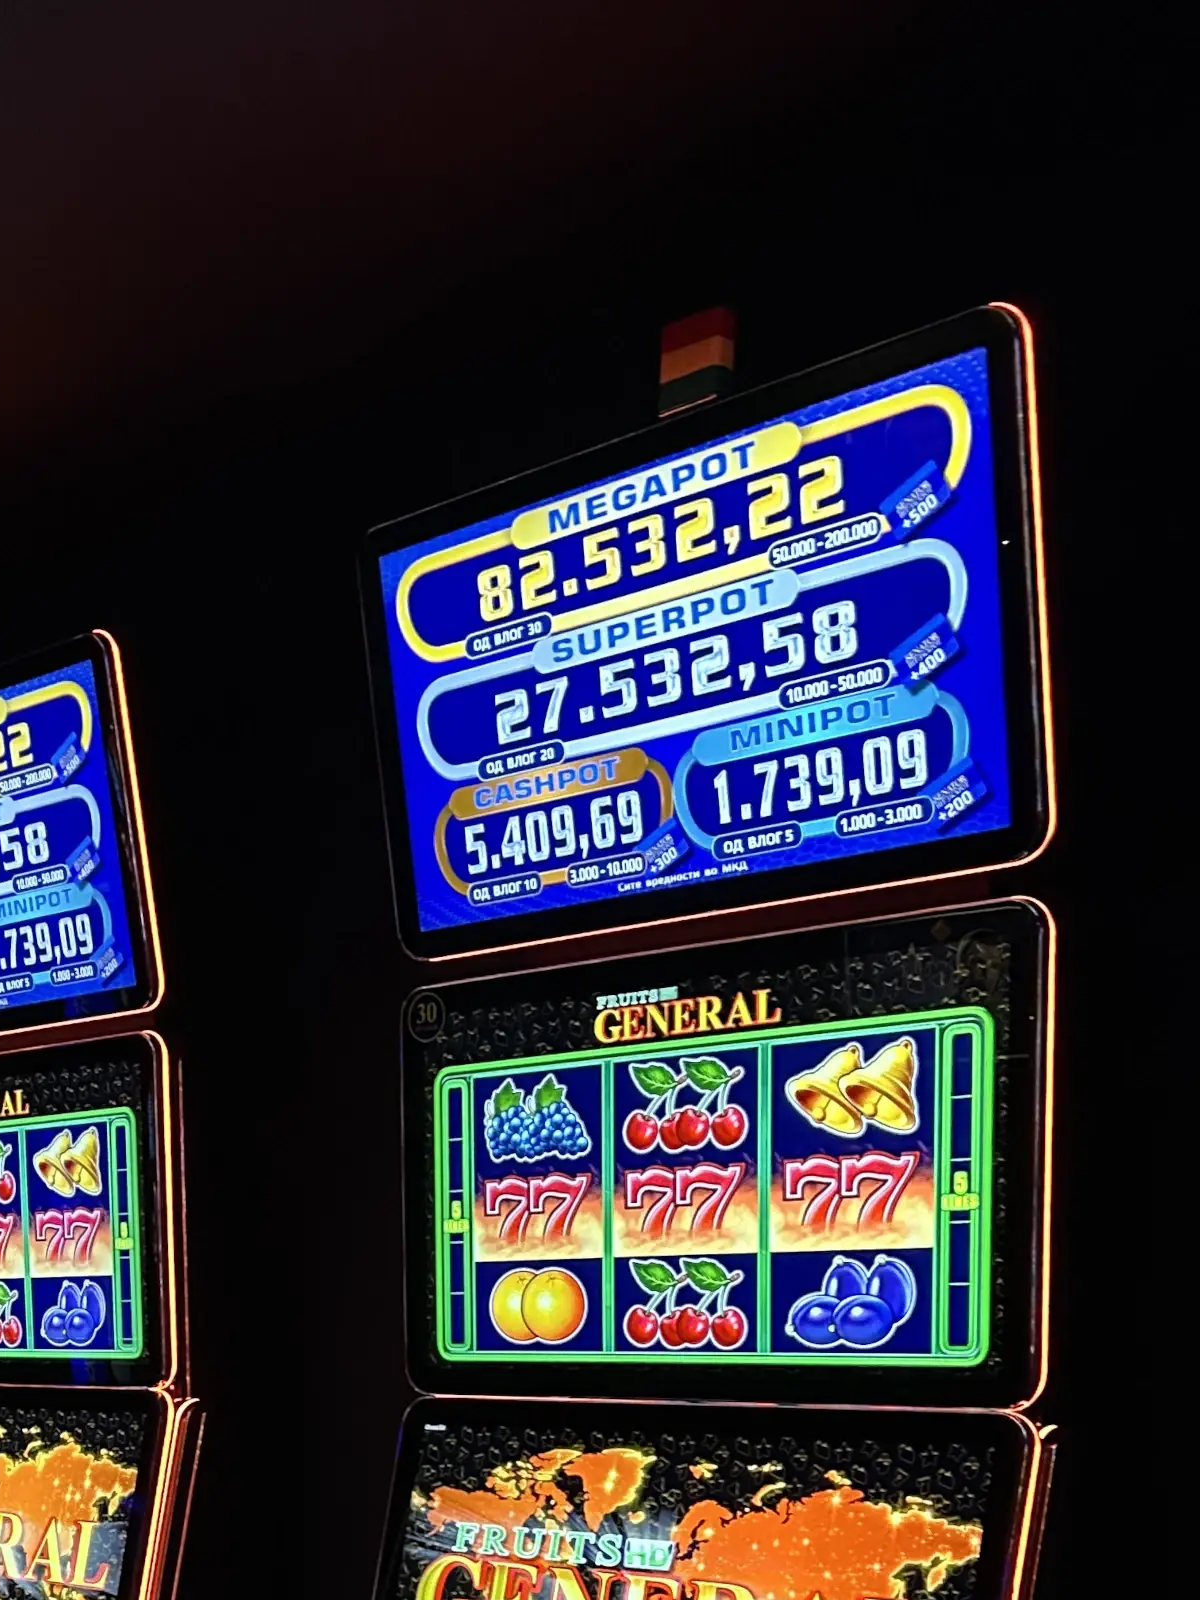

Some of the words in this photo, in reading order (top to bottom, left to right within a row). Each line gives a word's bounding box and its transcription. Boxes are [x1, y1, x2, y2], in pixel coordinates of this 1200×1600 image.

[548, 441, 755, 533] MEGAPOT
[902, 494, 938, 528] +500
[477, 455, 845, 622] 82.532,22
[473, 636, 491, 652] ОД
[494, 626, 524, 646] ВЛОГ
[527, 621, 542, 636] 30
[552, 579, 774, 663] SUPERPOT
[494, 600, 858, 745] 27.532,58
[910, 648, 947, 680] +400
[730, 693, 895, 751] MINIPOT
[486, 757, 504, 774] ОД
[507, 751, 536, 769] ВЛОГ
[540, 747, 555, 762] 20
[713, 728, 928, 825] 1.739,09
[474, 756, 620, 809] CASHPOT
[938, 790, 974, 820] +200
[464, 790, 643, 875] 5.409,69
[723, 838, 744, 855] ОД
[748, 832, 784, 850] ВЛОГ
[785, 829, 794, 843] 5
[650, 846, 678, 873] +300
[722, 860, 749, 874] МКД
[473, 884, 490, 901] ОД
[493, 880, 523, 897] ВЛОГ
[524, 878, 538, 892] 10
[416, 1002, 438, 1024] 30
[593, 989, 782, 1044] GENERAL
[596, 989, 658, 1010] FRUITS
[451, 1521, 622, 1566] FRUITS
[626, 1538, 675, 1571] HD
